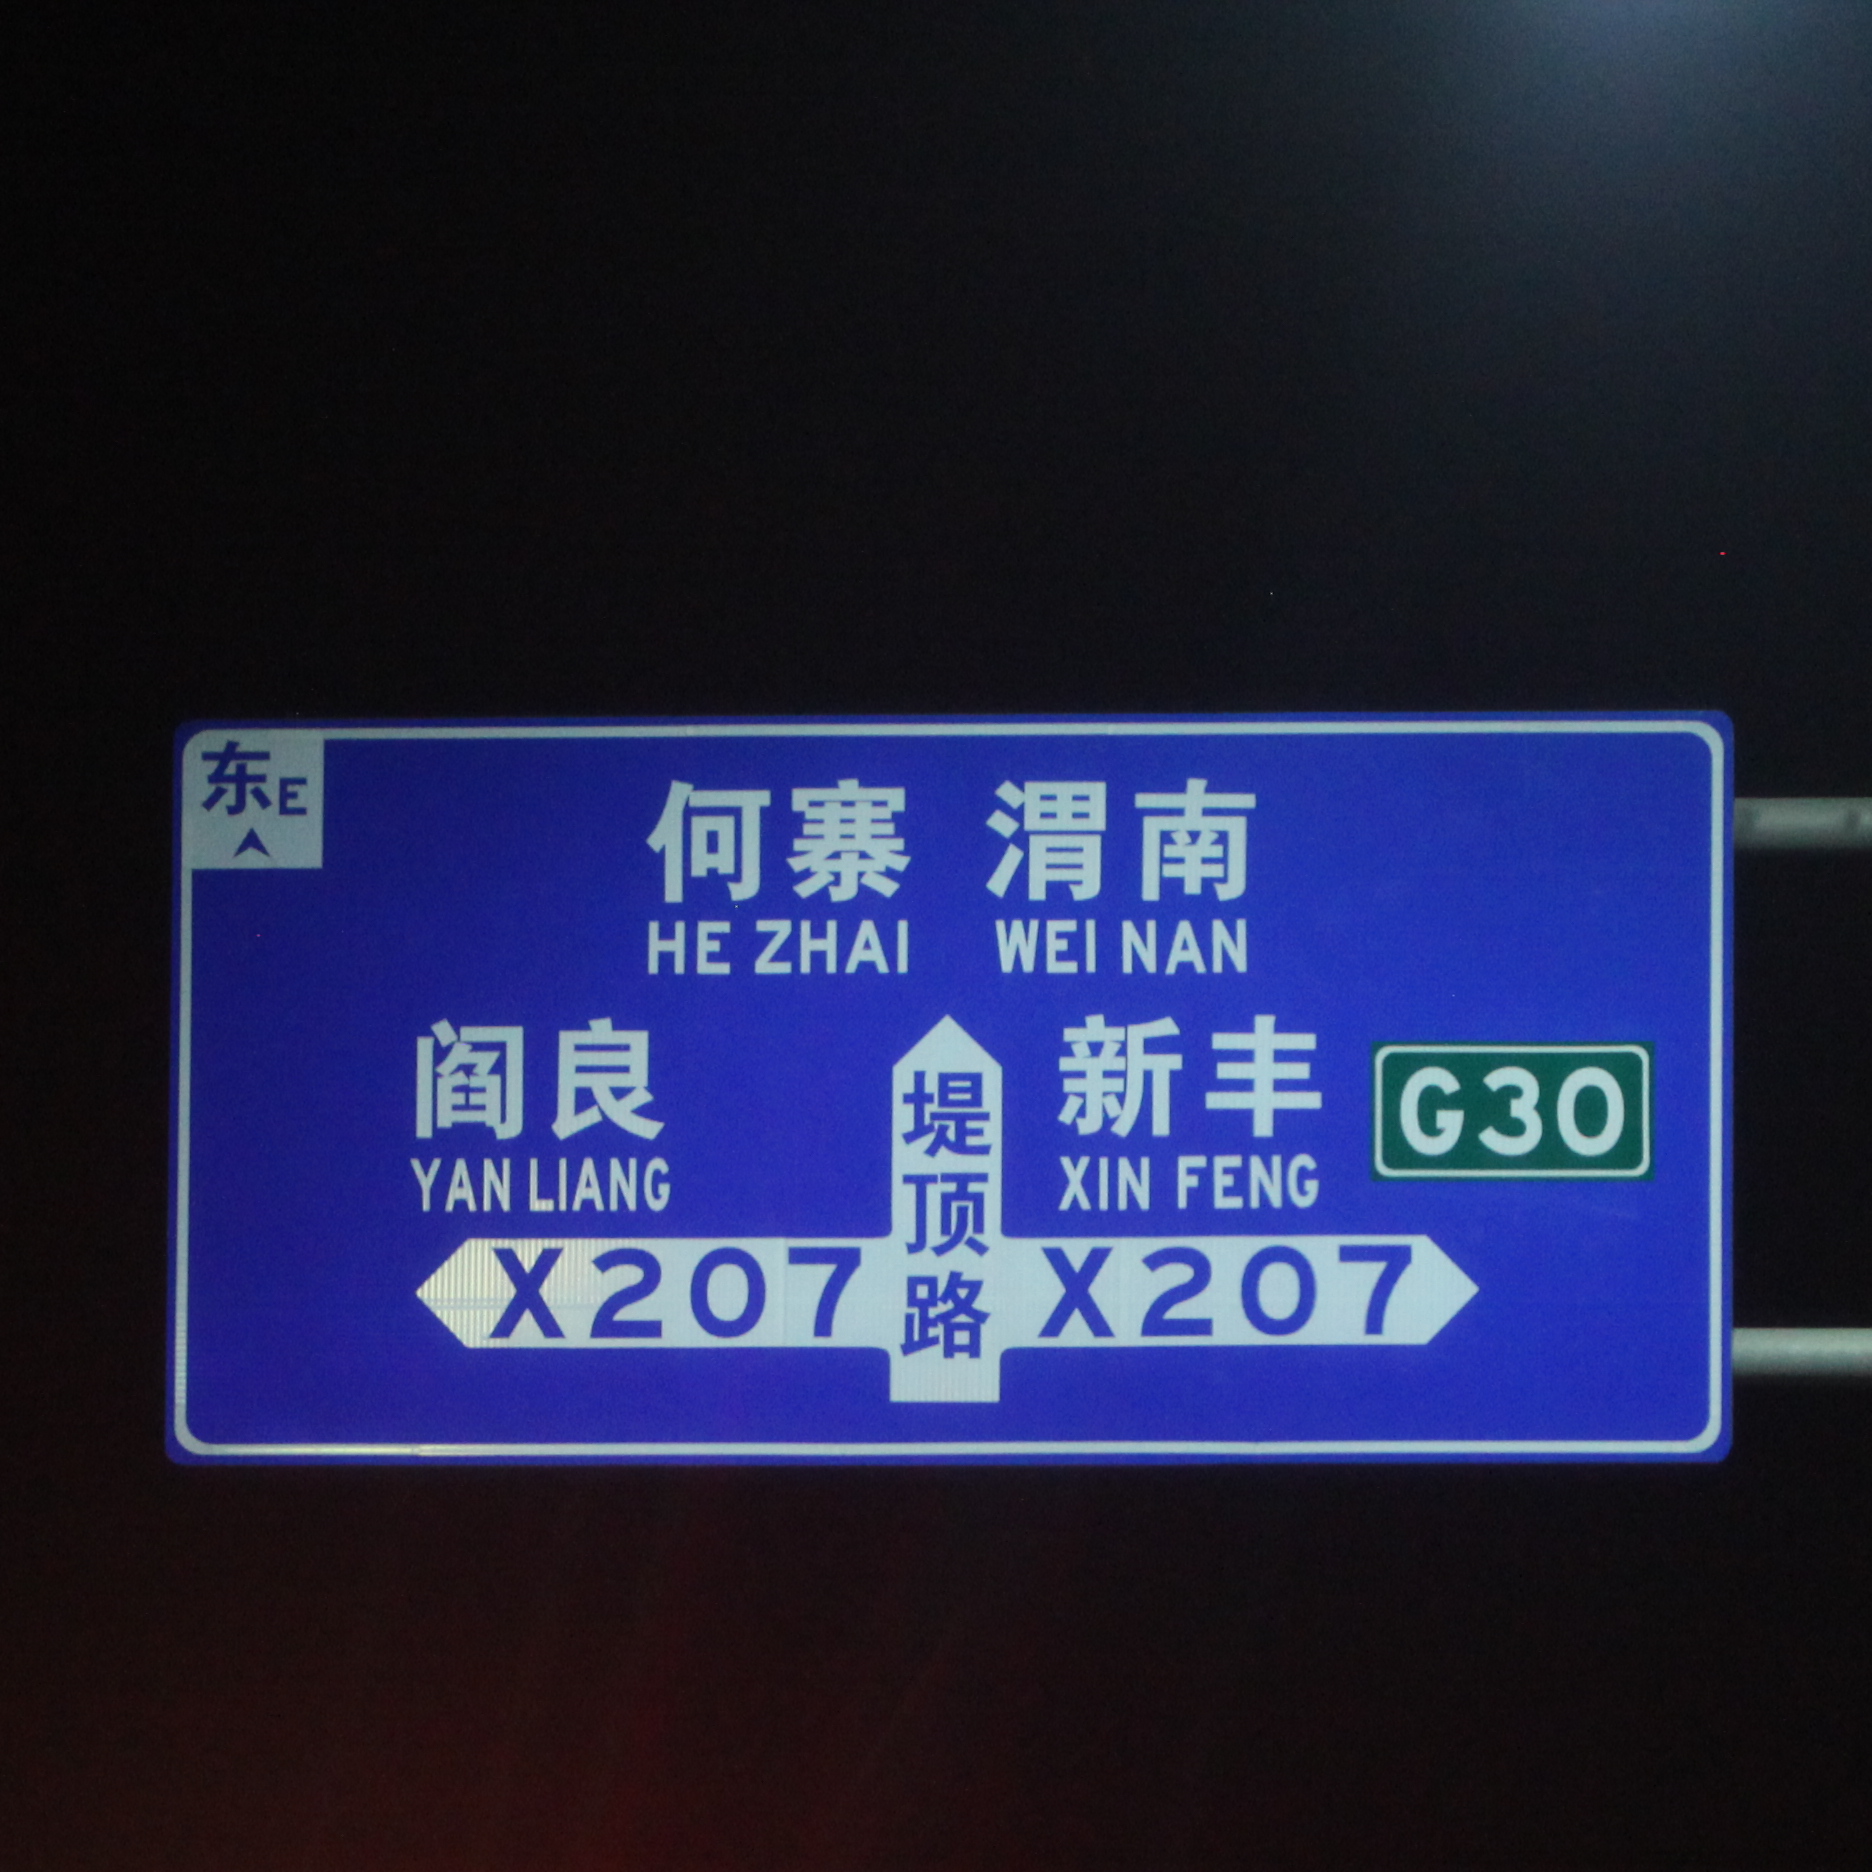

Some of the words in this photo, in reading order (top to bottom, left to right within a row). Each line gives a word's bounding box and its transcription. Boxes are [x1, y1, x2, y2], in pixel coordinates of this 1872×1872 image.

[201, 740, 271, 815] 东
[279, 777, 307, 815] E
[647, 779, 910, 902] 何寨
[986, 778, 1256, 901] 渭南
[648, 921, 730, 974] HE
[755, 919, 908, 973] ZHAI
[996, 919, 1095, 973] WEI
[1122, 919, 1247, 974] NAN
[416, 1017, 664, 1140] 阎良
[1058, 1014, 1322, 1137] 新丰
[1400, 1066, 1624, 1156] G30
[411, 1158, 510, 1212] YAN
[530, 1157, 670, 1211] LIANG
[901, 1071, 991, 1358] 堤顶路
[1059, 1156, 1149, 1210] XIN
[1178, 1153, 1318, 1209] FENG
[489, 1247, 861, 1338] X207
[1039, 1245, 1412, 1337] X207
